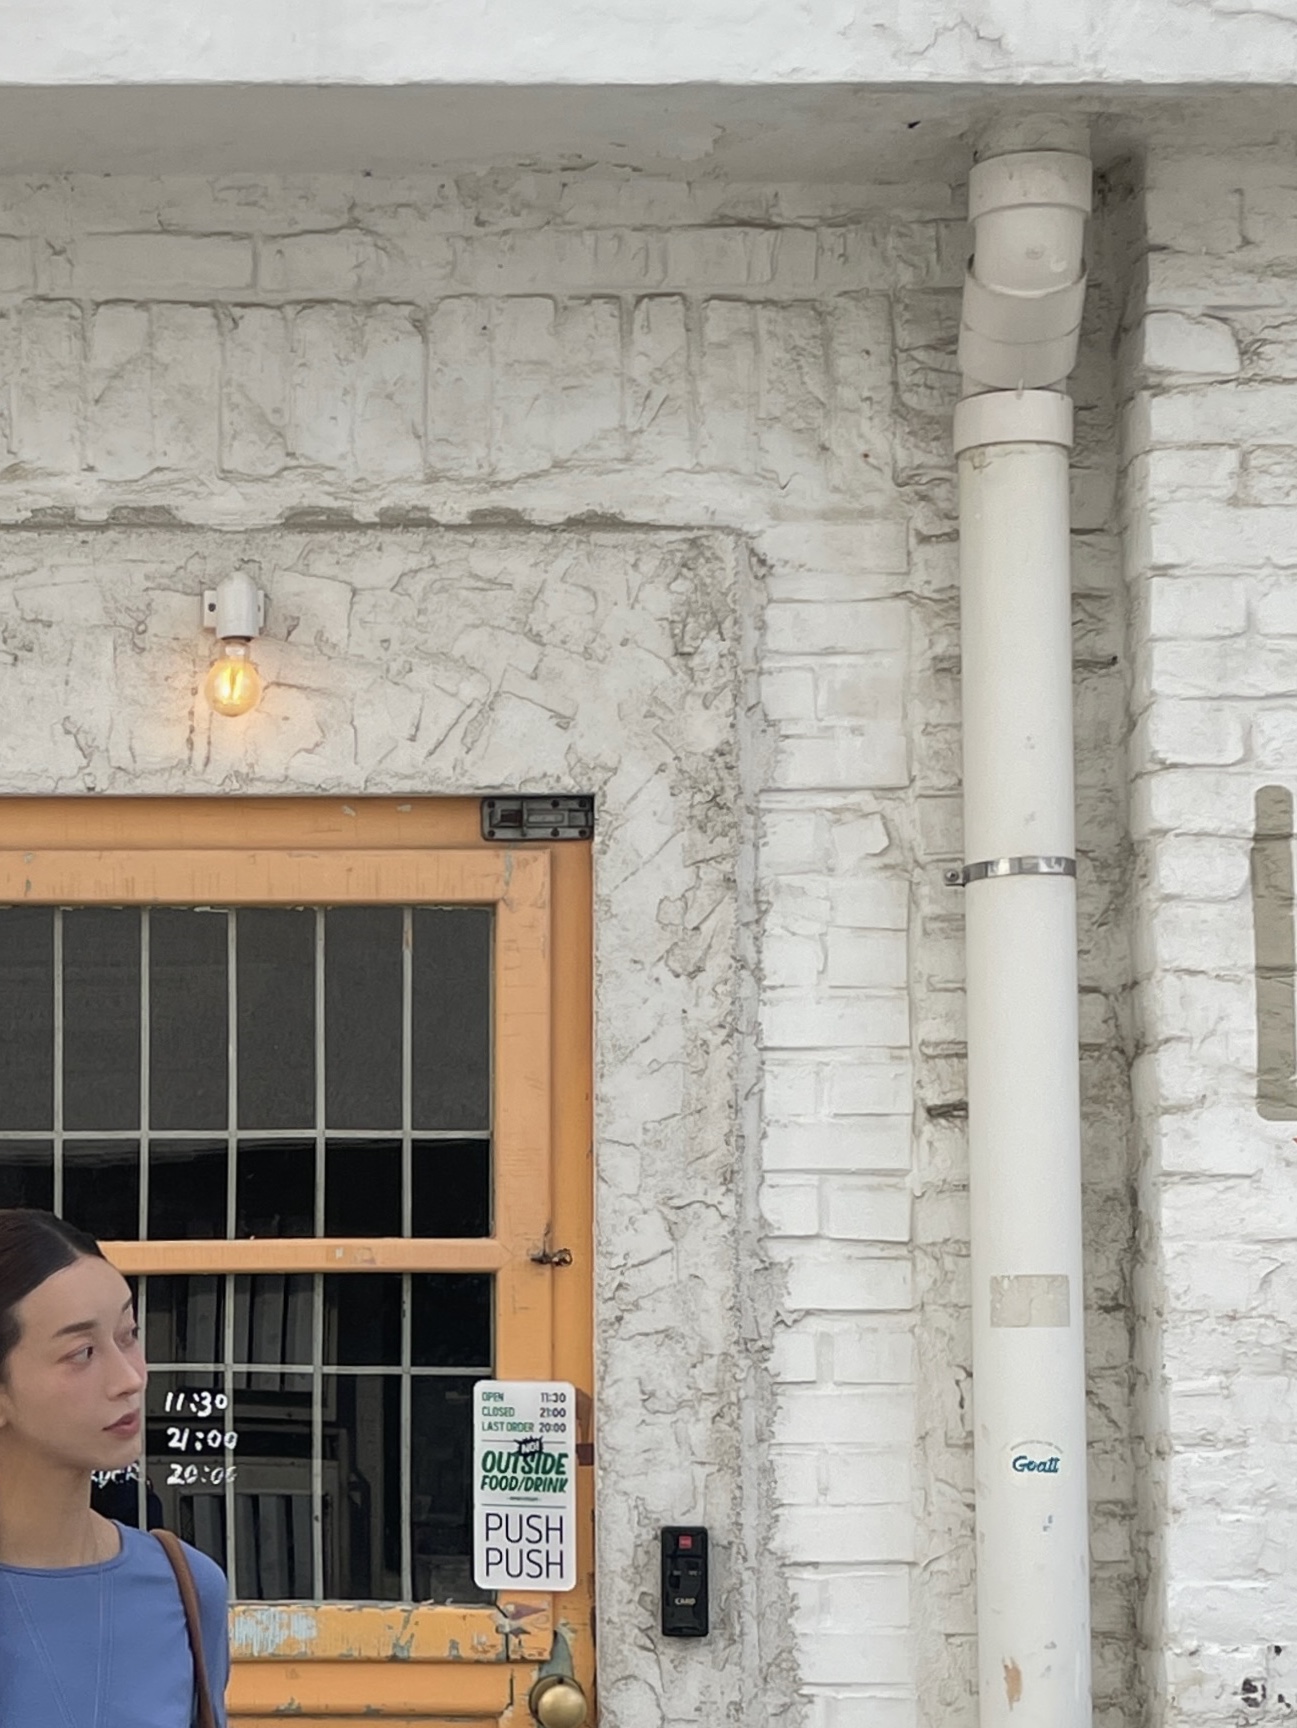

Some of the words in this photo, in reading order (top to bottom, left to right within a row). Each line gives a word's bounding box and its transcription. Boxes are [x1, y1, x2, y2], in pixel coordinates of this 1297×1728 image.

[165, 1391, 228, 1417] 11:30
[481, 1391, 504, 1401] OPEN
[540, 1392, 567, 1403] 11:30
[481, 1406, 515, 1417] CLOSED
[539, 1407, 567, 1418] 21:00
[166, 1427, 238, 1451] 21:00
[481, 1421, 505, 1432] LAST
[506, 1422, 535, 1433] ORDER
[538, 1422, 567, 1433] 20:00
[481, 1450, 569, 1475] OUTSIDE
[480, 1474, 569, 1493] FOOD/DRINK
[484, 1512, 565, 1545] PUSH
[484, 1547, 565, 1579] PUSH
